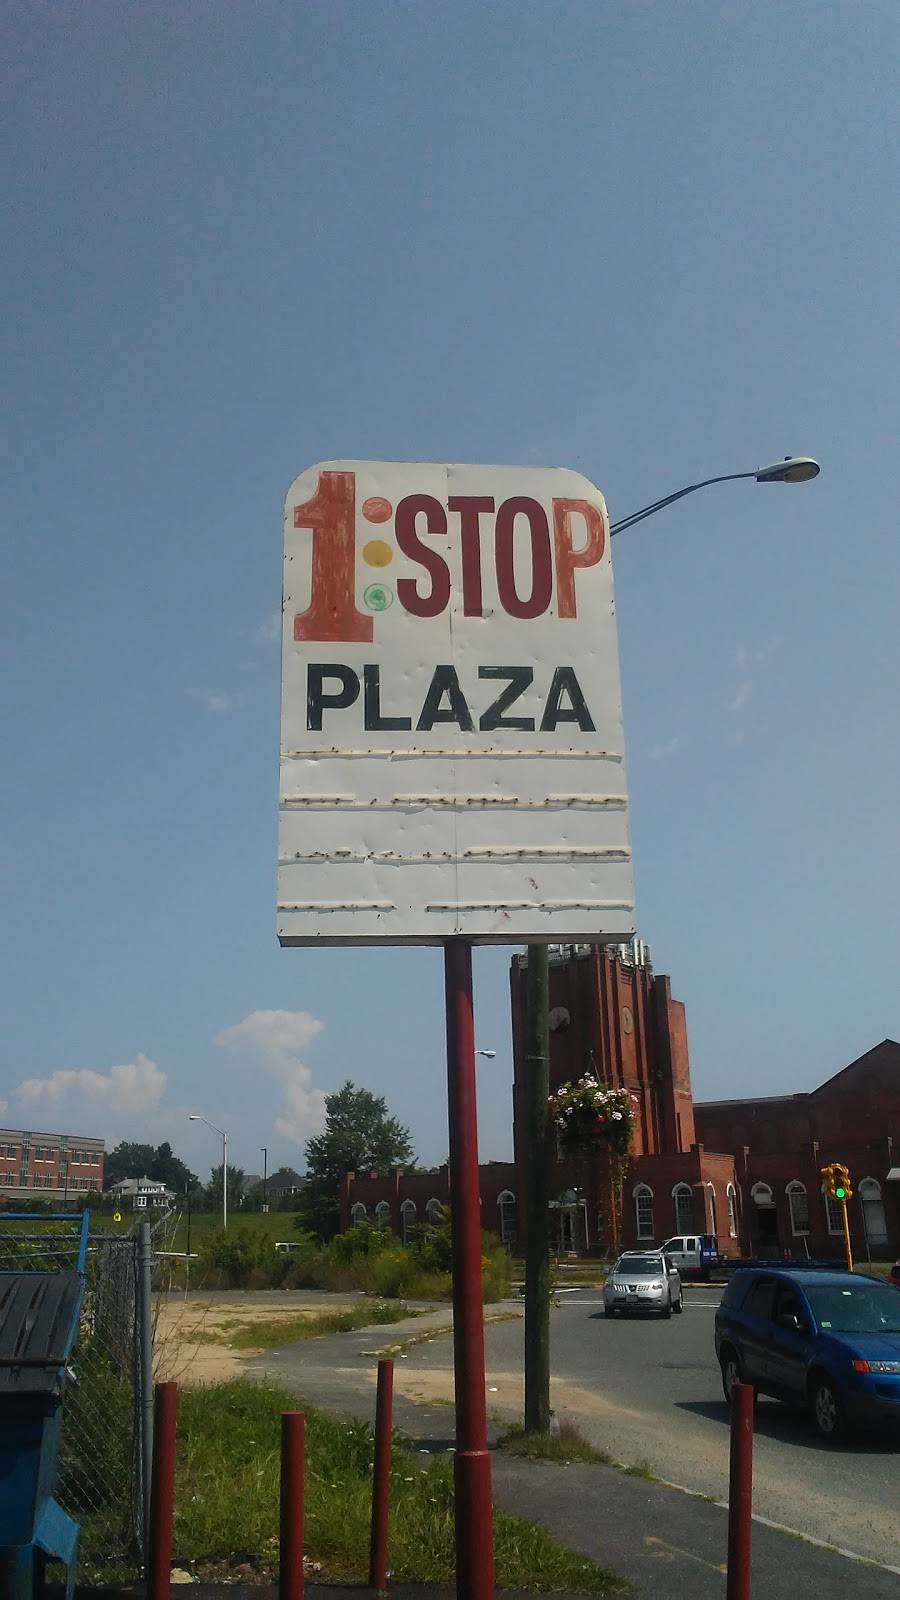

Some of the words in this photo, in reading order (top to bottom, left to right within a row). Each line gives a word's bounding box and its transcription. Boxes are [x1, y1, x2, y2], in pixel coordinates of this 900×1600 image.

[294, 471, 373, 643] 1
[395, 494, 605, 619] STOP
[306, 663, 596, 732] PLAZA
